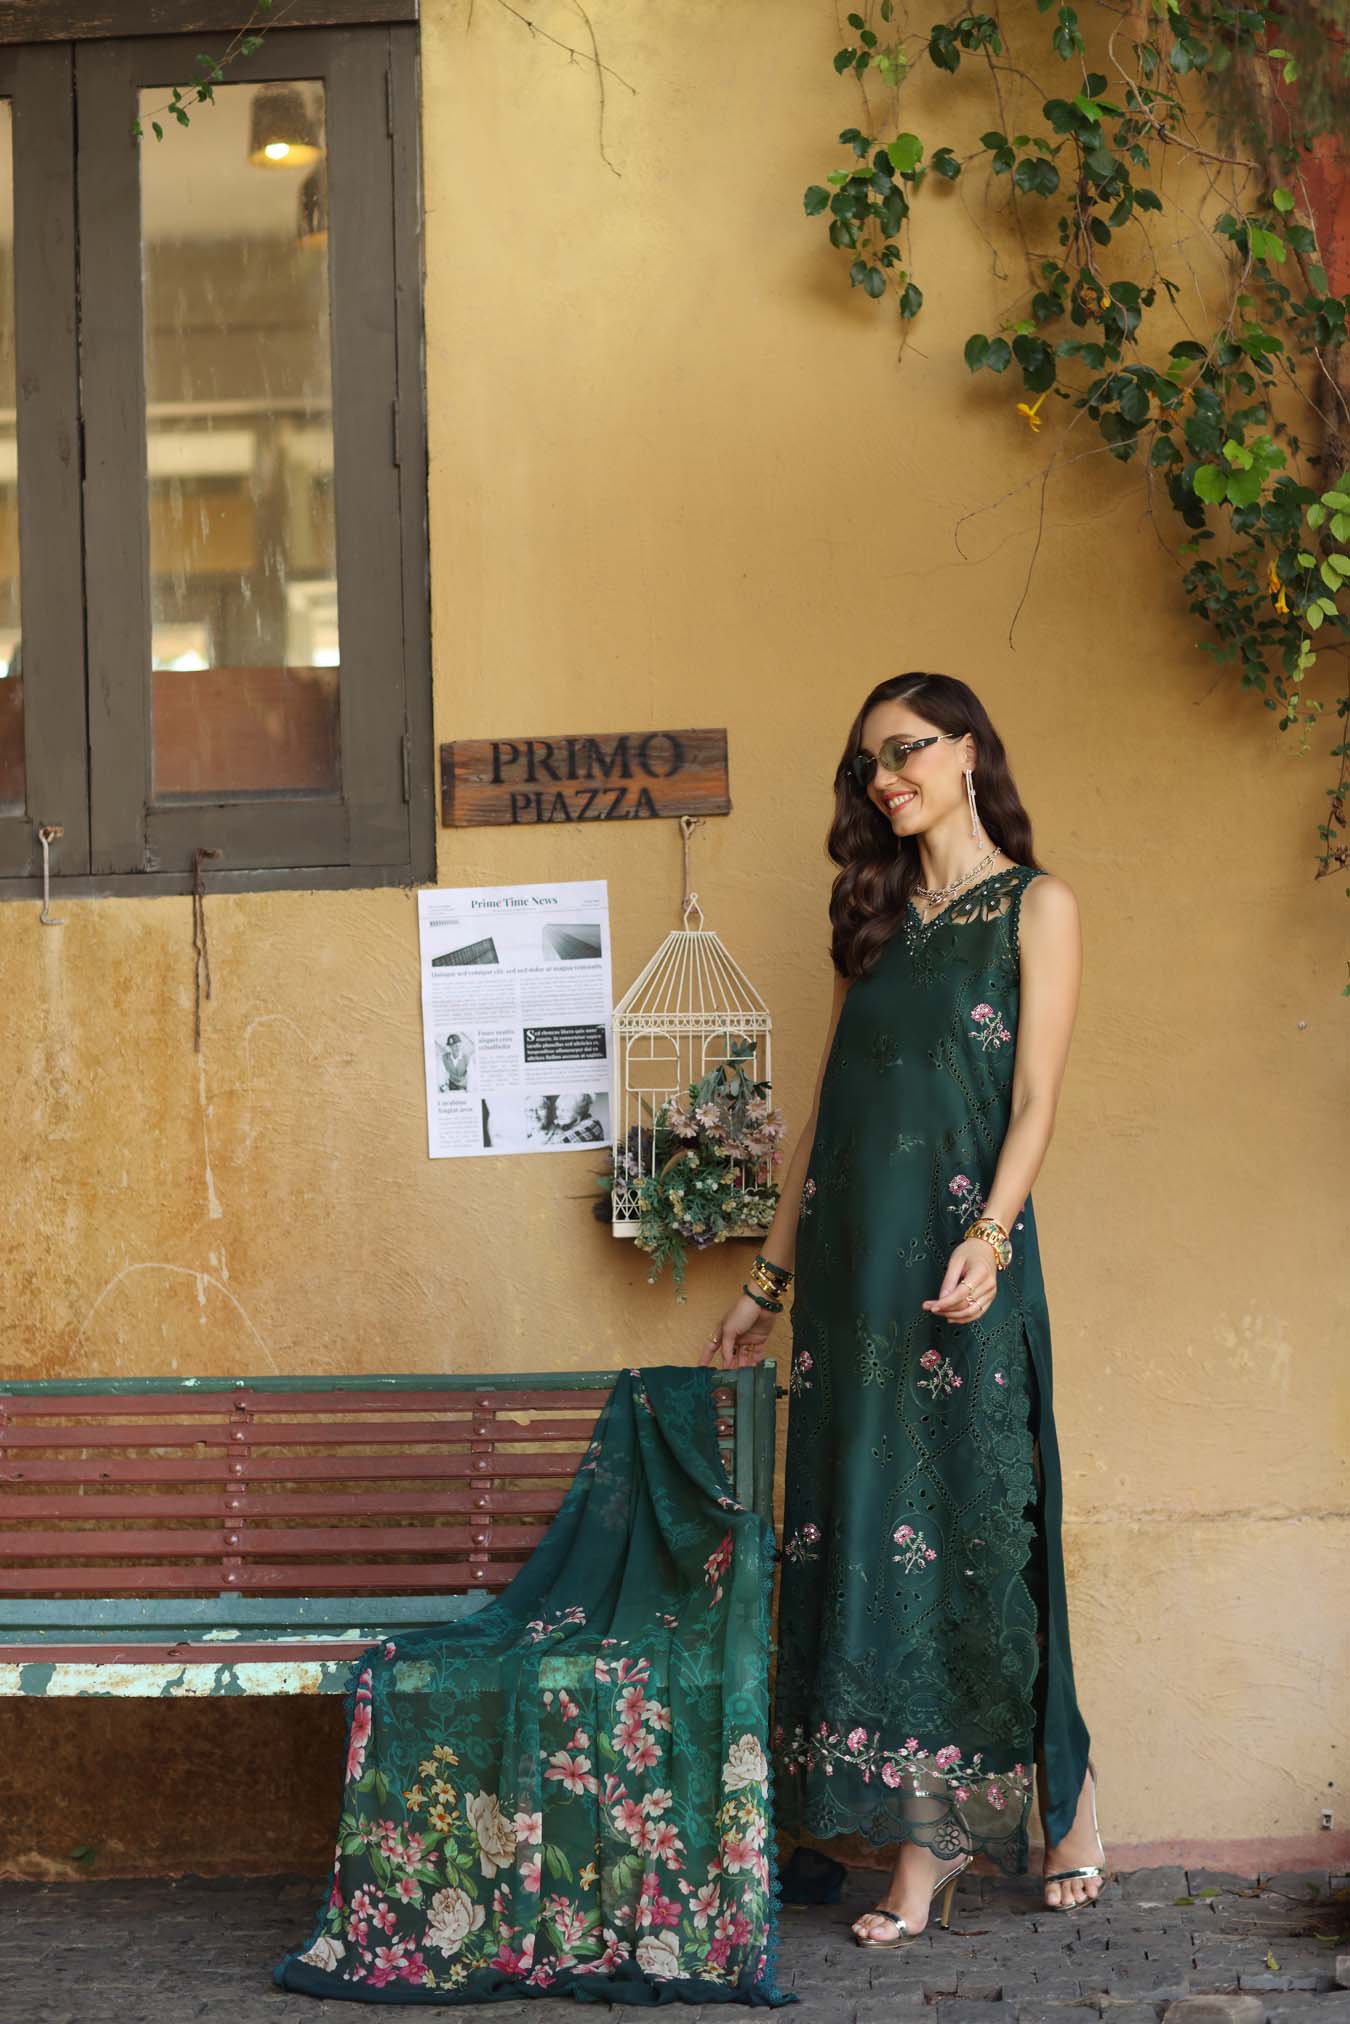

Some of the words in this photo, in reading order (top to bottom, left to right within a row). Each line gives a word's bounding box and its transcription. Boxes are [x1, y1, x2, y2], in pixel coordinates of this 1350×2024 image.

[489, 733, 685, 784] PRIMO
[510, 786, 660, 823] PIAZZA
[471, 898, 501, 909] Prime
[502, 897, 529, 908] Time
[531, 896, 559, 906] News
